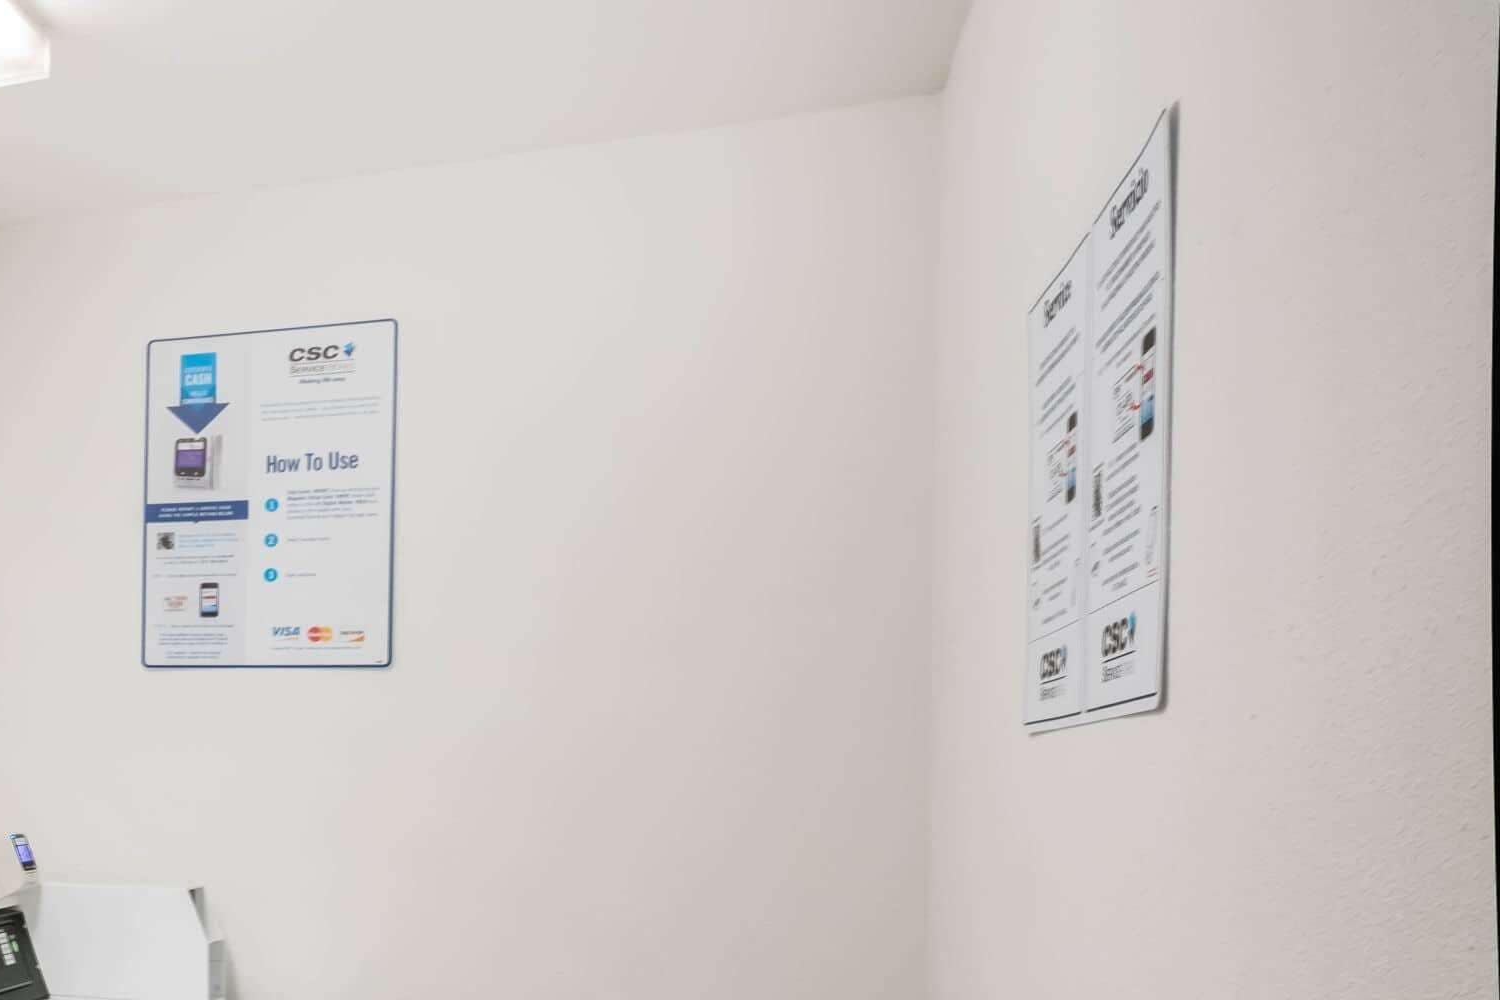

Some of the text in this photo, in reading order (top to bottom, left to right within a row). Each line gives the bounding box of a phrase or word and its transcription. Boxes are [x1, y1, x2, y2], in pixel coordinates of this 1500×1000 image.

[289, 344, 339, 362] CSC
[265, 451, 359, 474] How To Use
[272, 627, 300, 637] VISA
[1101, 616, 1129, 657] CSC
[1040, 648, 1061, 681] CSC
